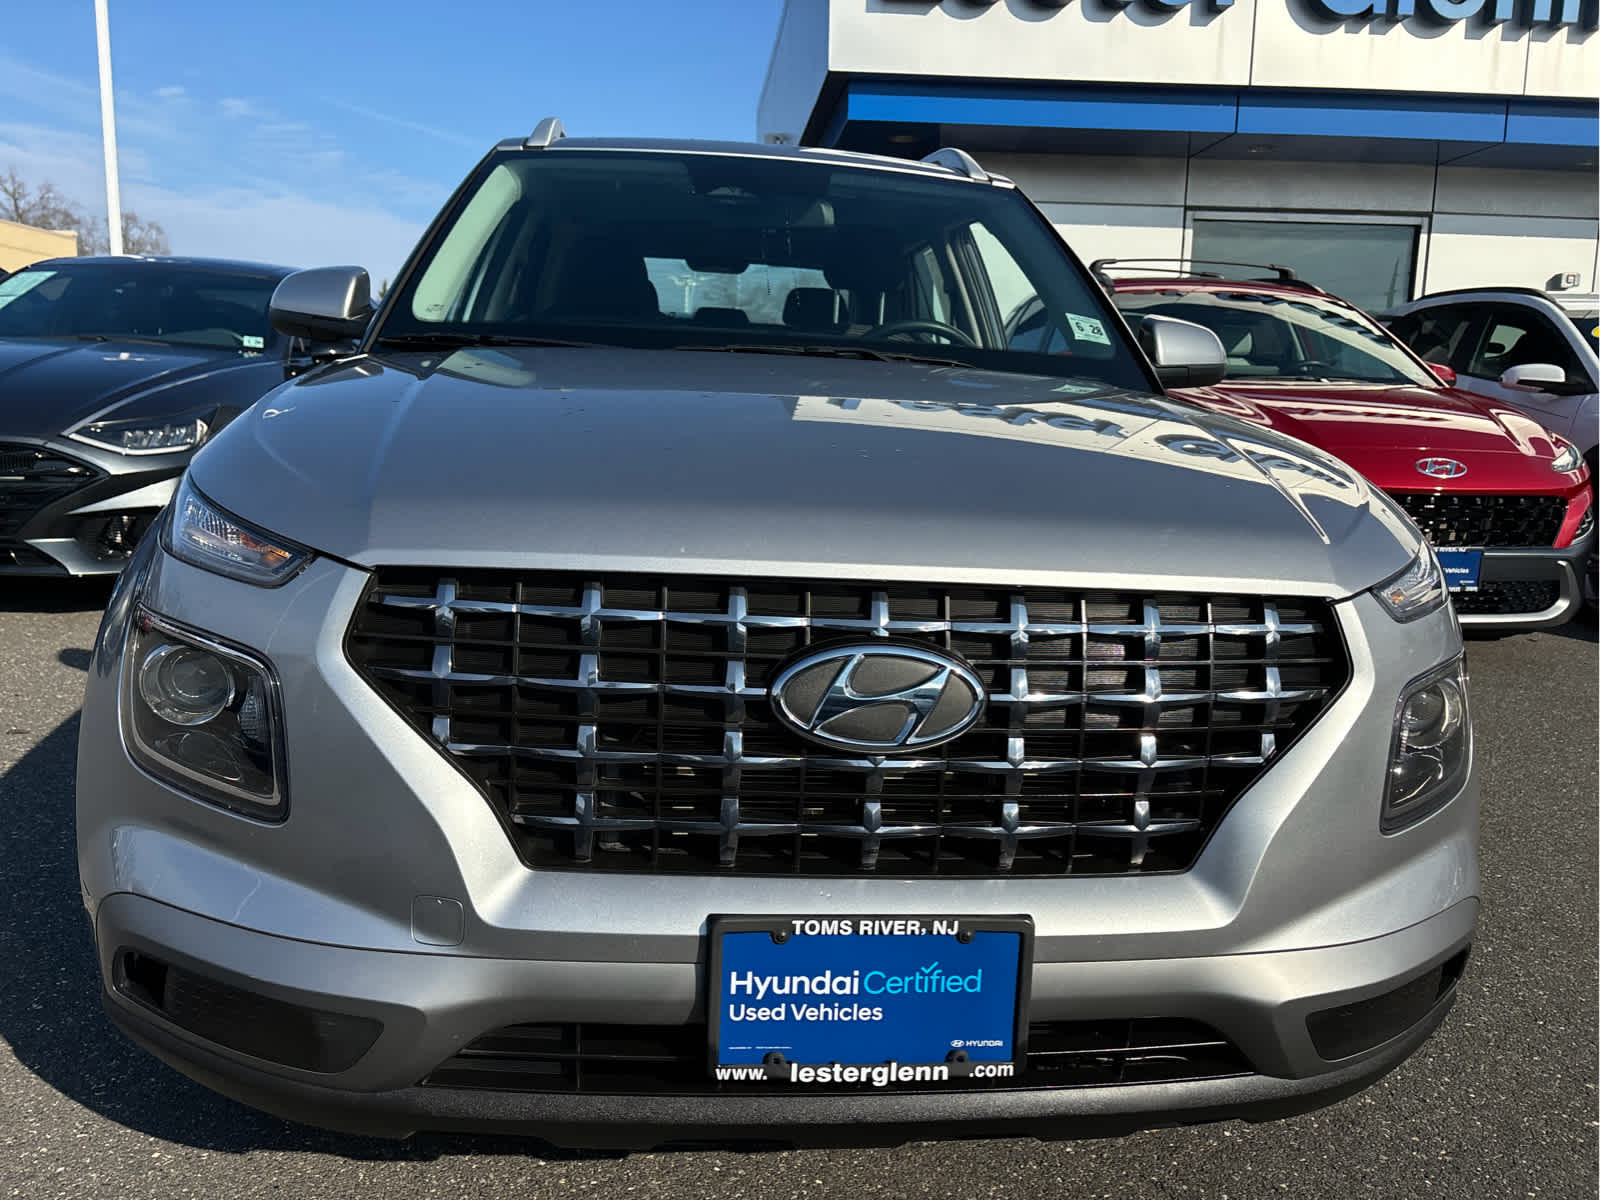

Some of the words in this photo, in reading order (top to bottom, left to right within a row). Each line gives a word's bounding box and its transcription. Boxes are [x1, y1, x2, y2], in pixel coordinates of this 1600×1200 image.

[792, 919, 852, 936] TOMS
[858, 920, 927, 937] RIVER,
[932, 920, 959, 936] NJ
[729, 969, 860, 1000] Hyundai
[862, 962, 983, 994] Certified
[728, 1002, 786, 1022] Used
[791, 1001, 884, 1022] Vehicles
[965, 1039, 1004, 1048] HYUNDAI
[715, 1065, 769, 1081] www.
[790, 1062, 949, 1087] lesterglenn
[968, 1062, 1015, 1079] .com
